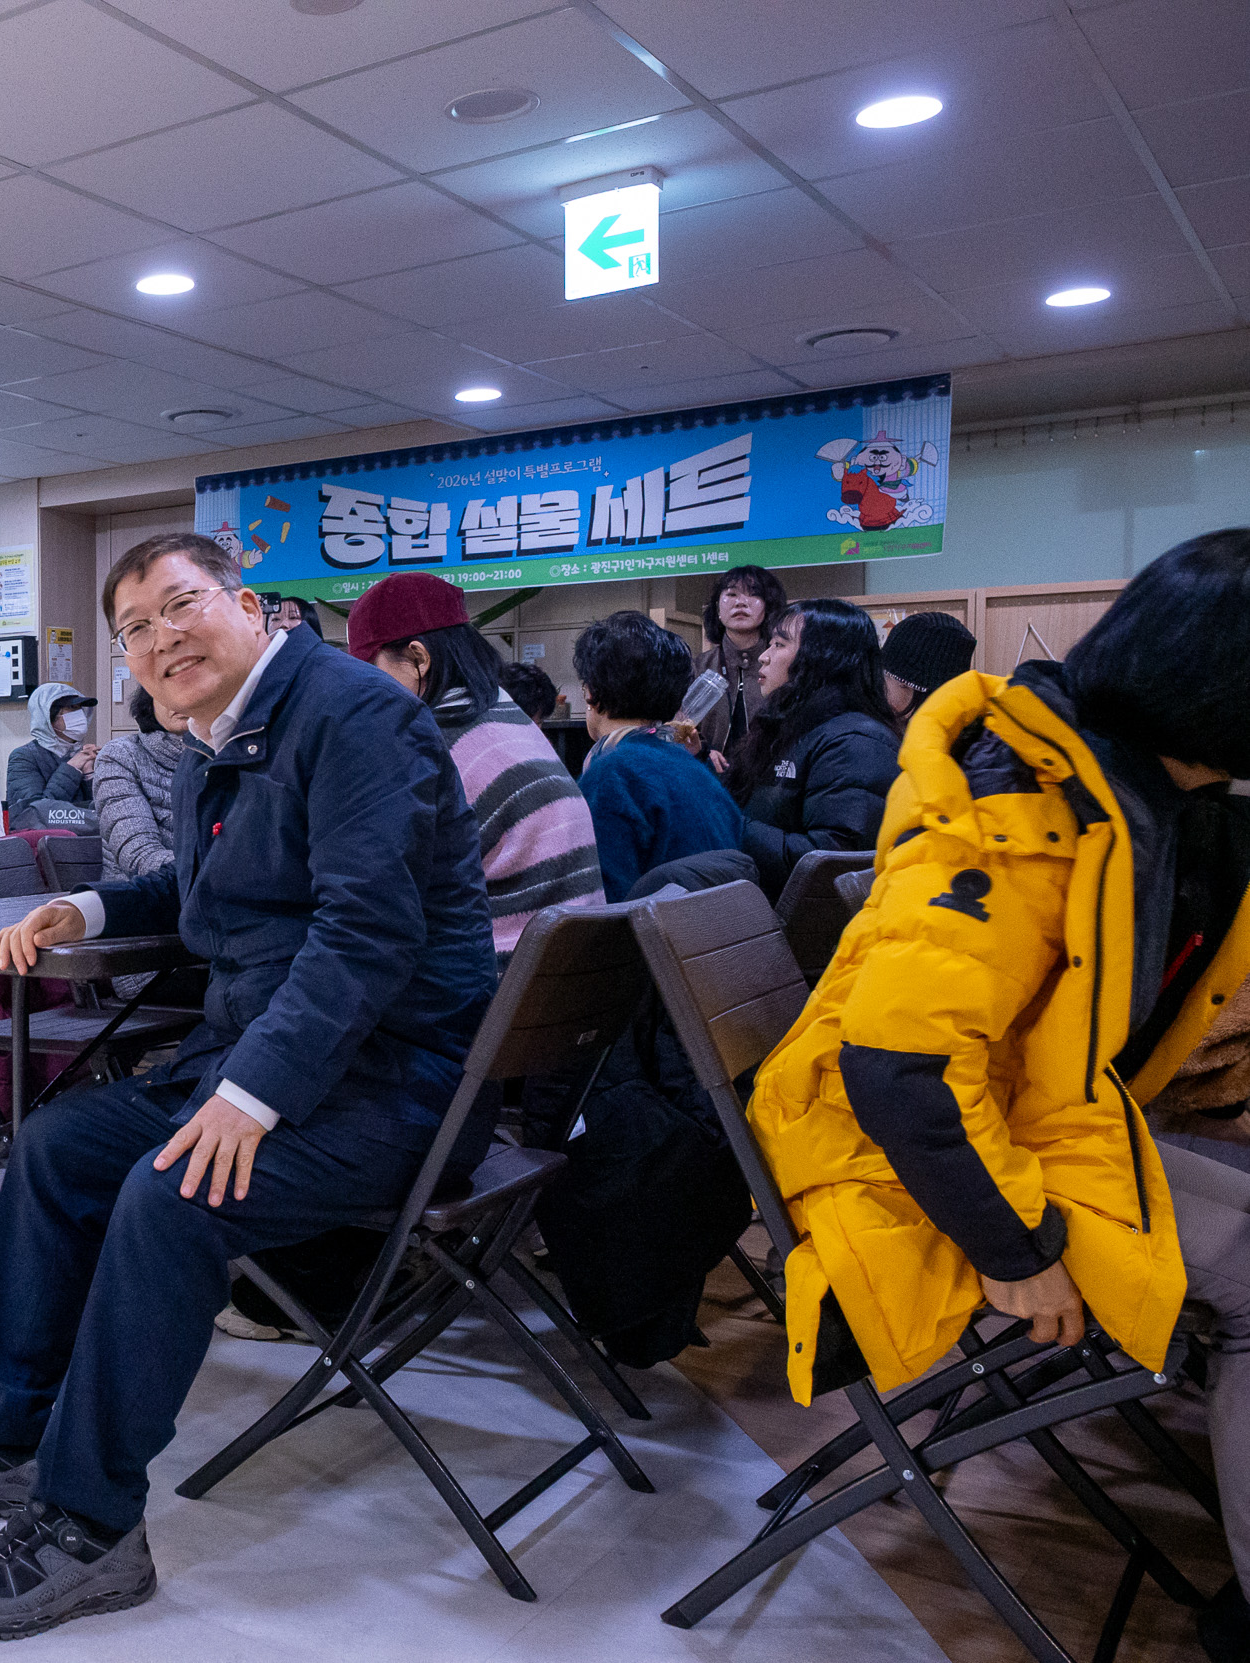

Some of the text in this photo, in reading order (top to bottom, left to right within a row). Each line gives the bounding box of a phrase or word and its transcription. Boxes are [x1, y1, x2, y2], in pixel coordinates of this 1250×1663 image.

[436, 456, 602, 489] 2026년 설맞이 특별프로그램
[320, 483, 451, 565] 종합
[588, 432, 753, 541] 세트
[561, 564, 581, 577] 장소
[590, 554, 698, 574] 광진구1인가구지원센터
[701, 552, 729, 564] 1센터
[342, 582, 359, 593] 일시
[458, 568, 522, 583] 19:00~21:00
[48, 809, 85, 819] KOLON
